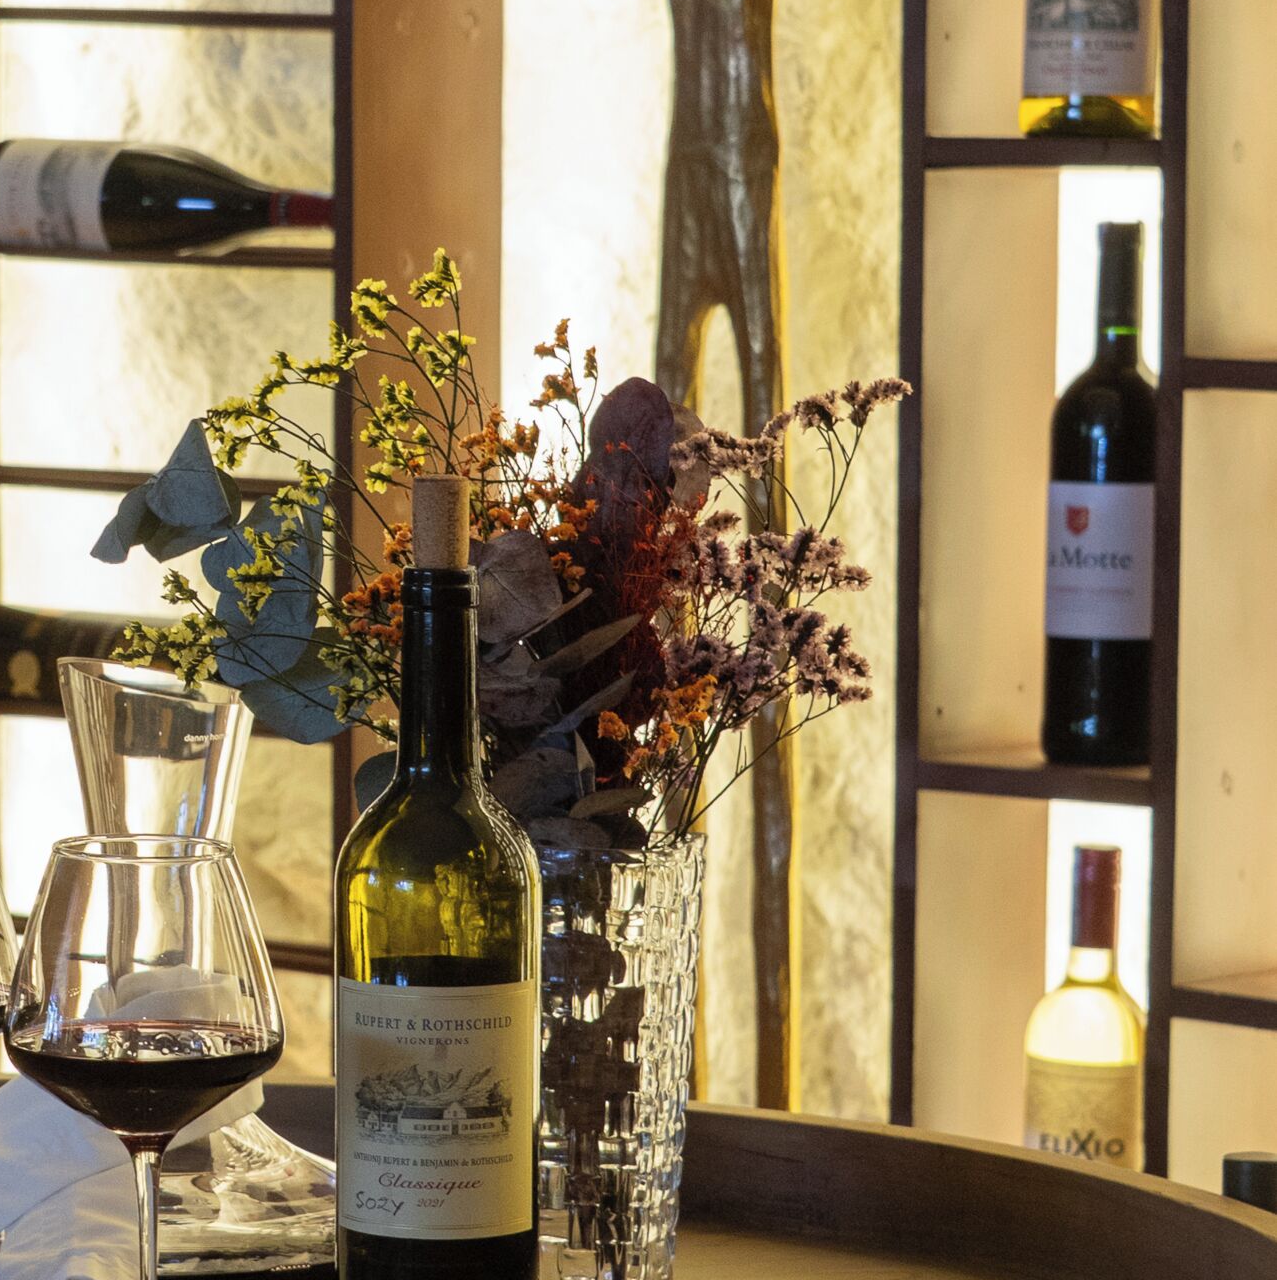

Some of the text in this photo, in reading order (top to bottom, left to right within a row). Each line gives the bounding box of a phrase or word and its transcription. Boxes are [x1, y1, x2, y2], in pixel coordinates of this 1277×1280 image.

[1060, 546, 1133, 569] Motte
[183, 733, 209, 743] danny
[355, 1012, 512, 1031] RUPERT & ROTHSCHILD
[396, 1036, 469, 1046] VIGNERONS
[383, 1156, 410, 1167] RUPERT
[420, 1158, 459, 1169] BENJAMIN
[471, 1153, 514, 1167] ROTHSCHILD
[378, 1172, 482, 1195] Classique
[416, 1198, 446, 1208] 2021
